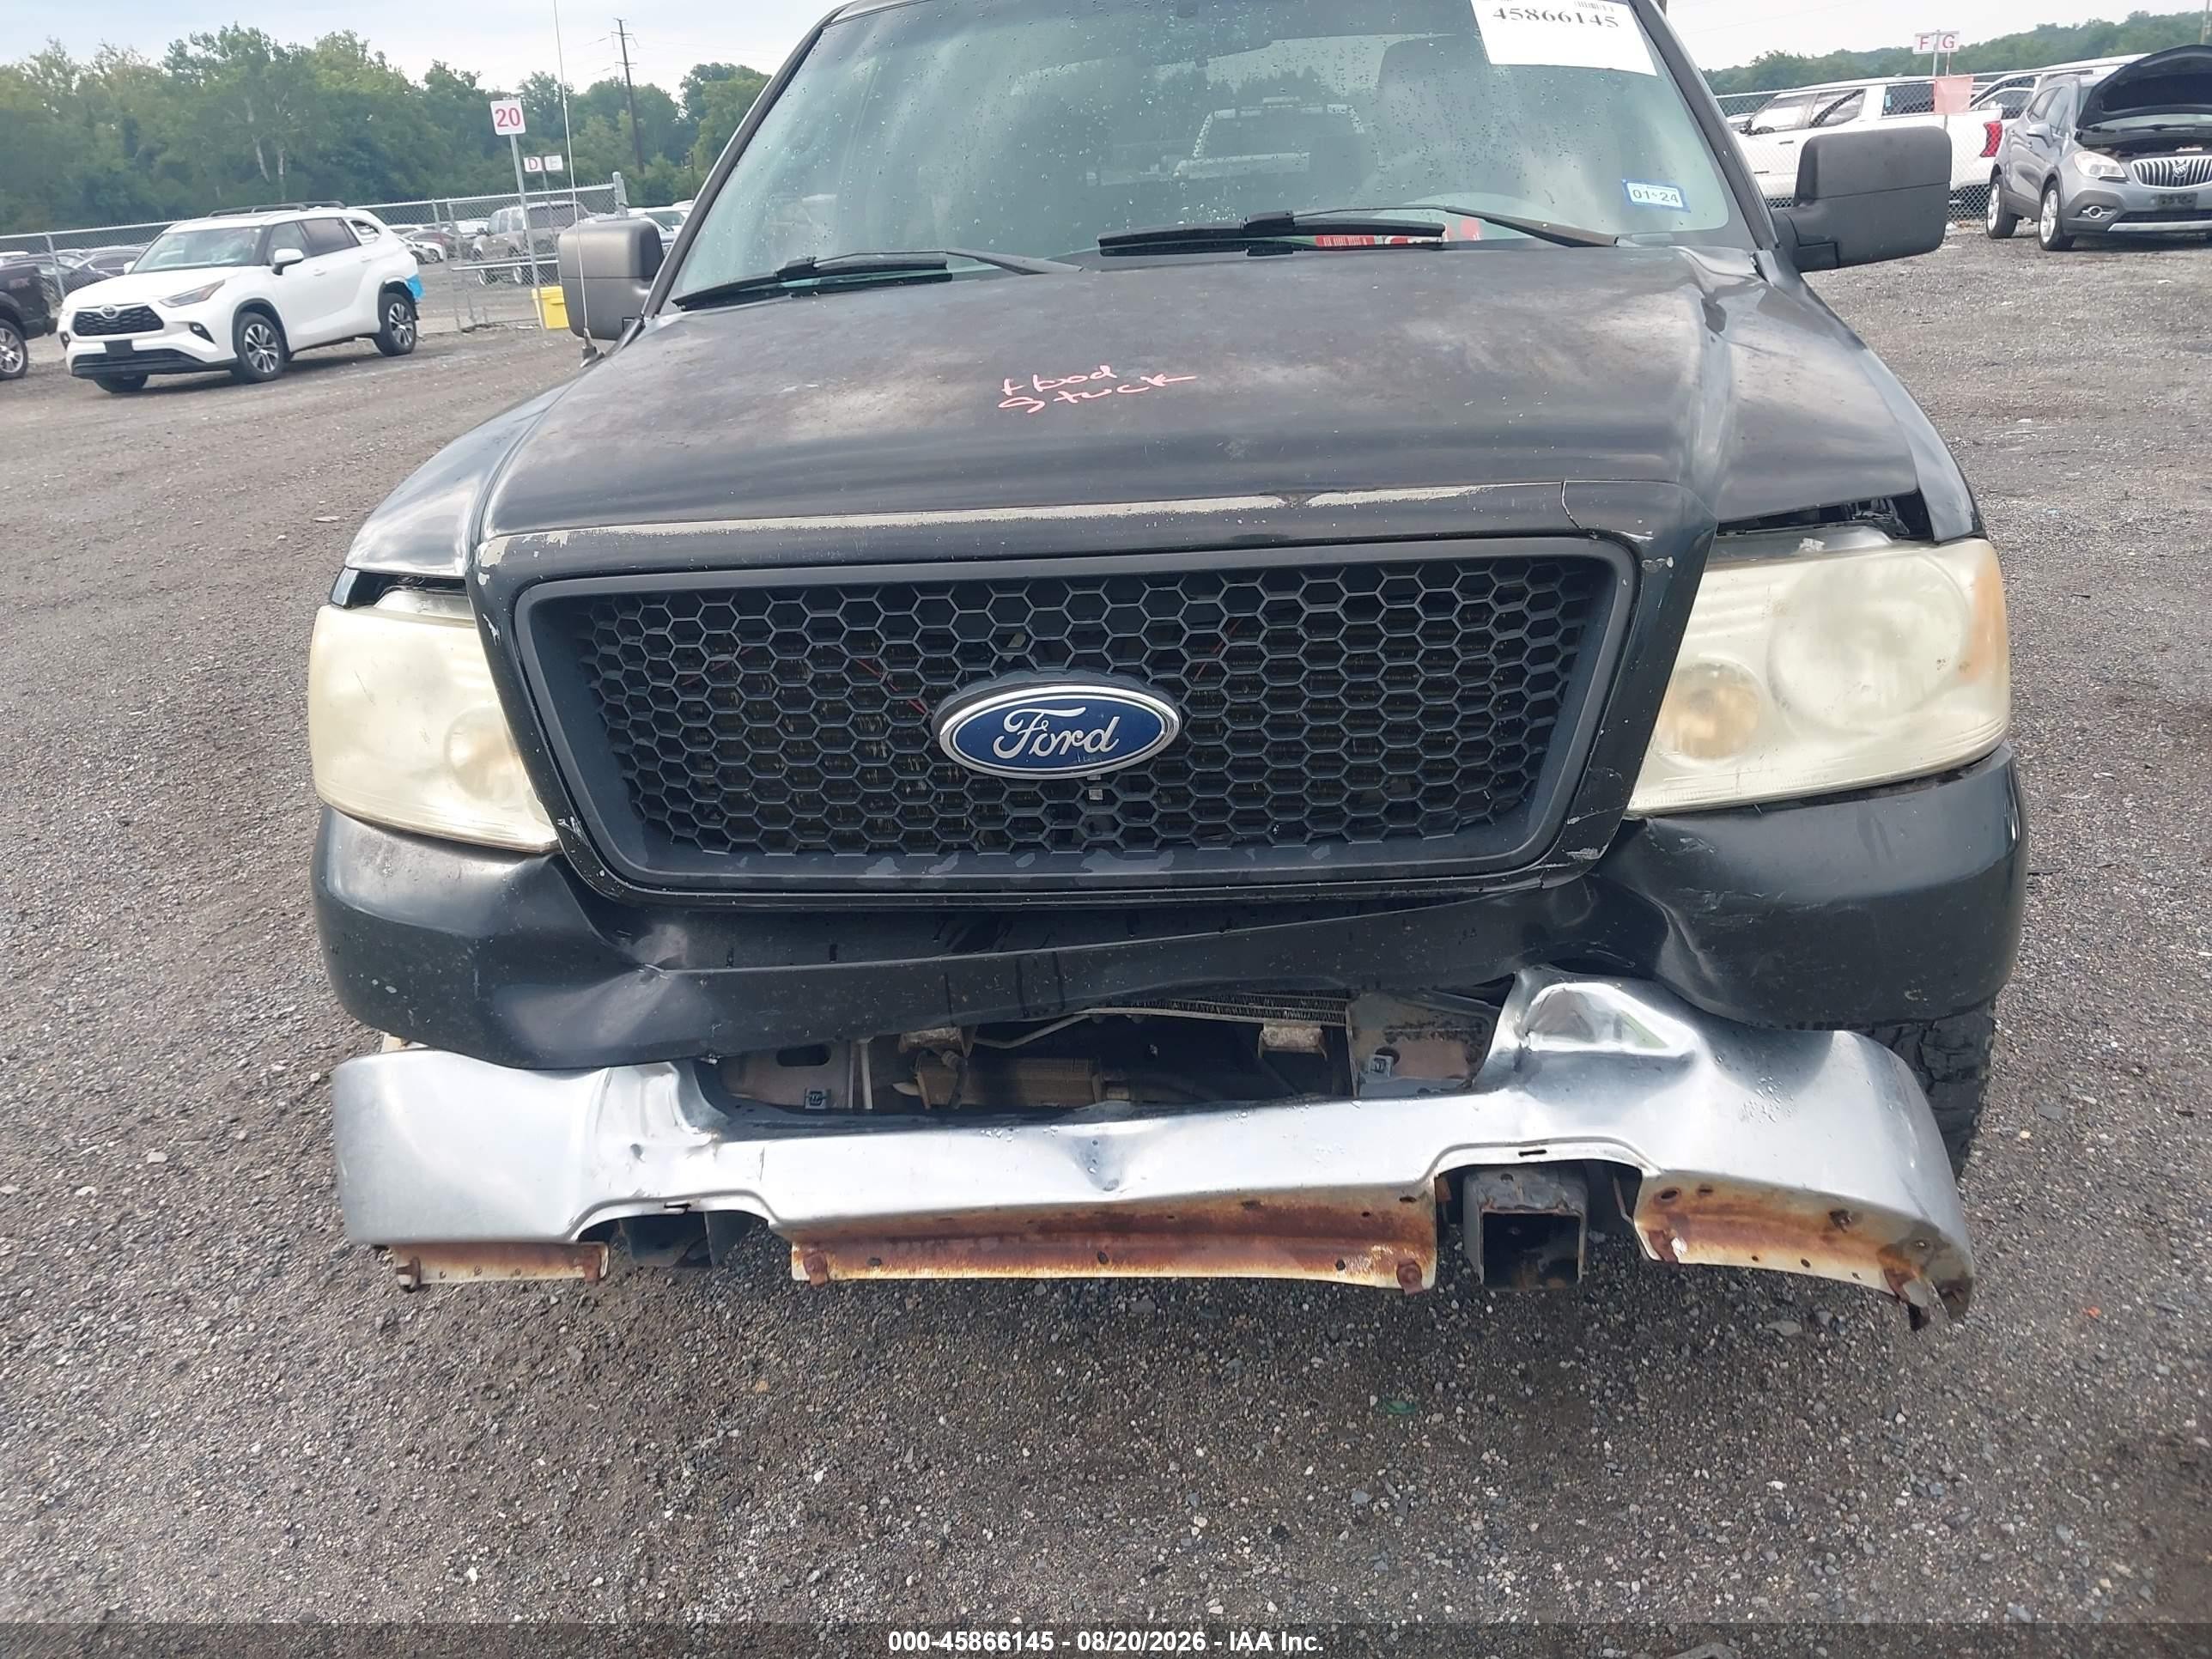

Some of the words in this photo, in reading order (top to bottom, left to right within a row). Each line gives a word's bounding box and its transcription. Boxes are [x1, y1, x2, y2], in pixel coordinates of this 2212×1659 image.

[1492, 7, 1620, 27] 45866145
[1919, 36, 1930, 51] F
[1942, 34, 1955, 49] G
[495, 107, 521, 128] 20
[528, 157, 538, 171] D
[993, 707, 1121, 759] Ford
